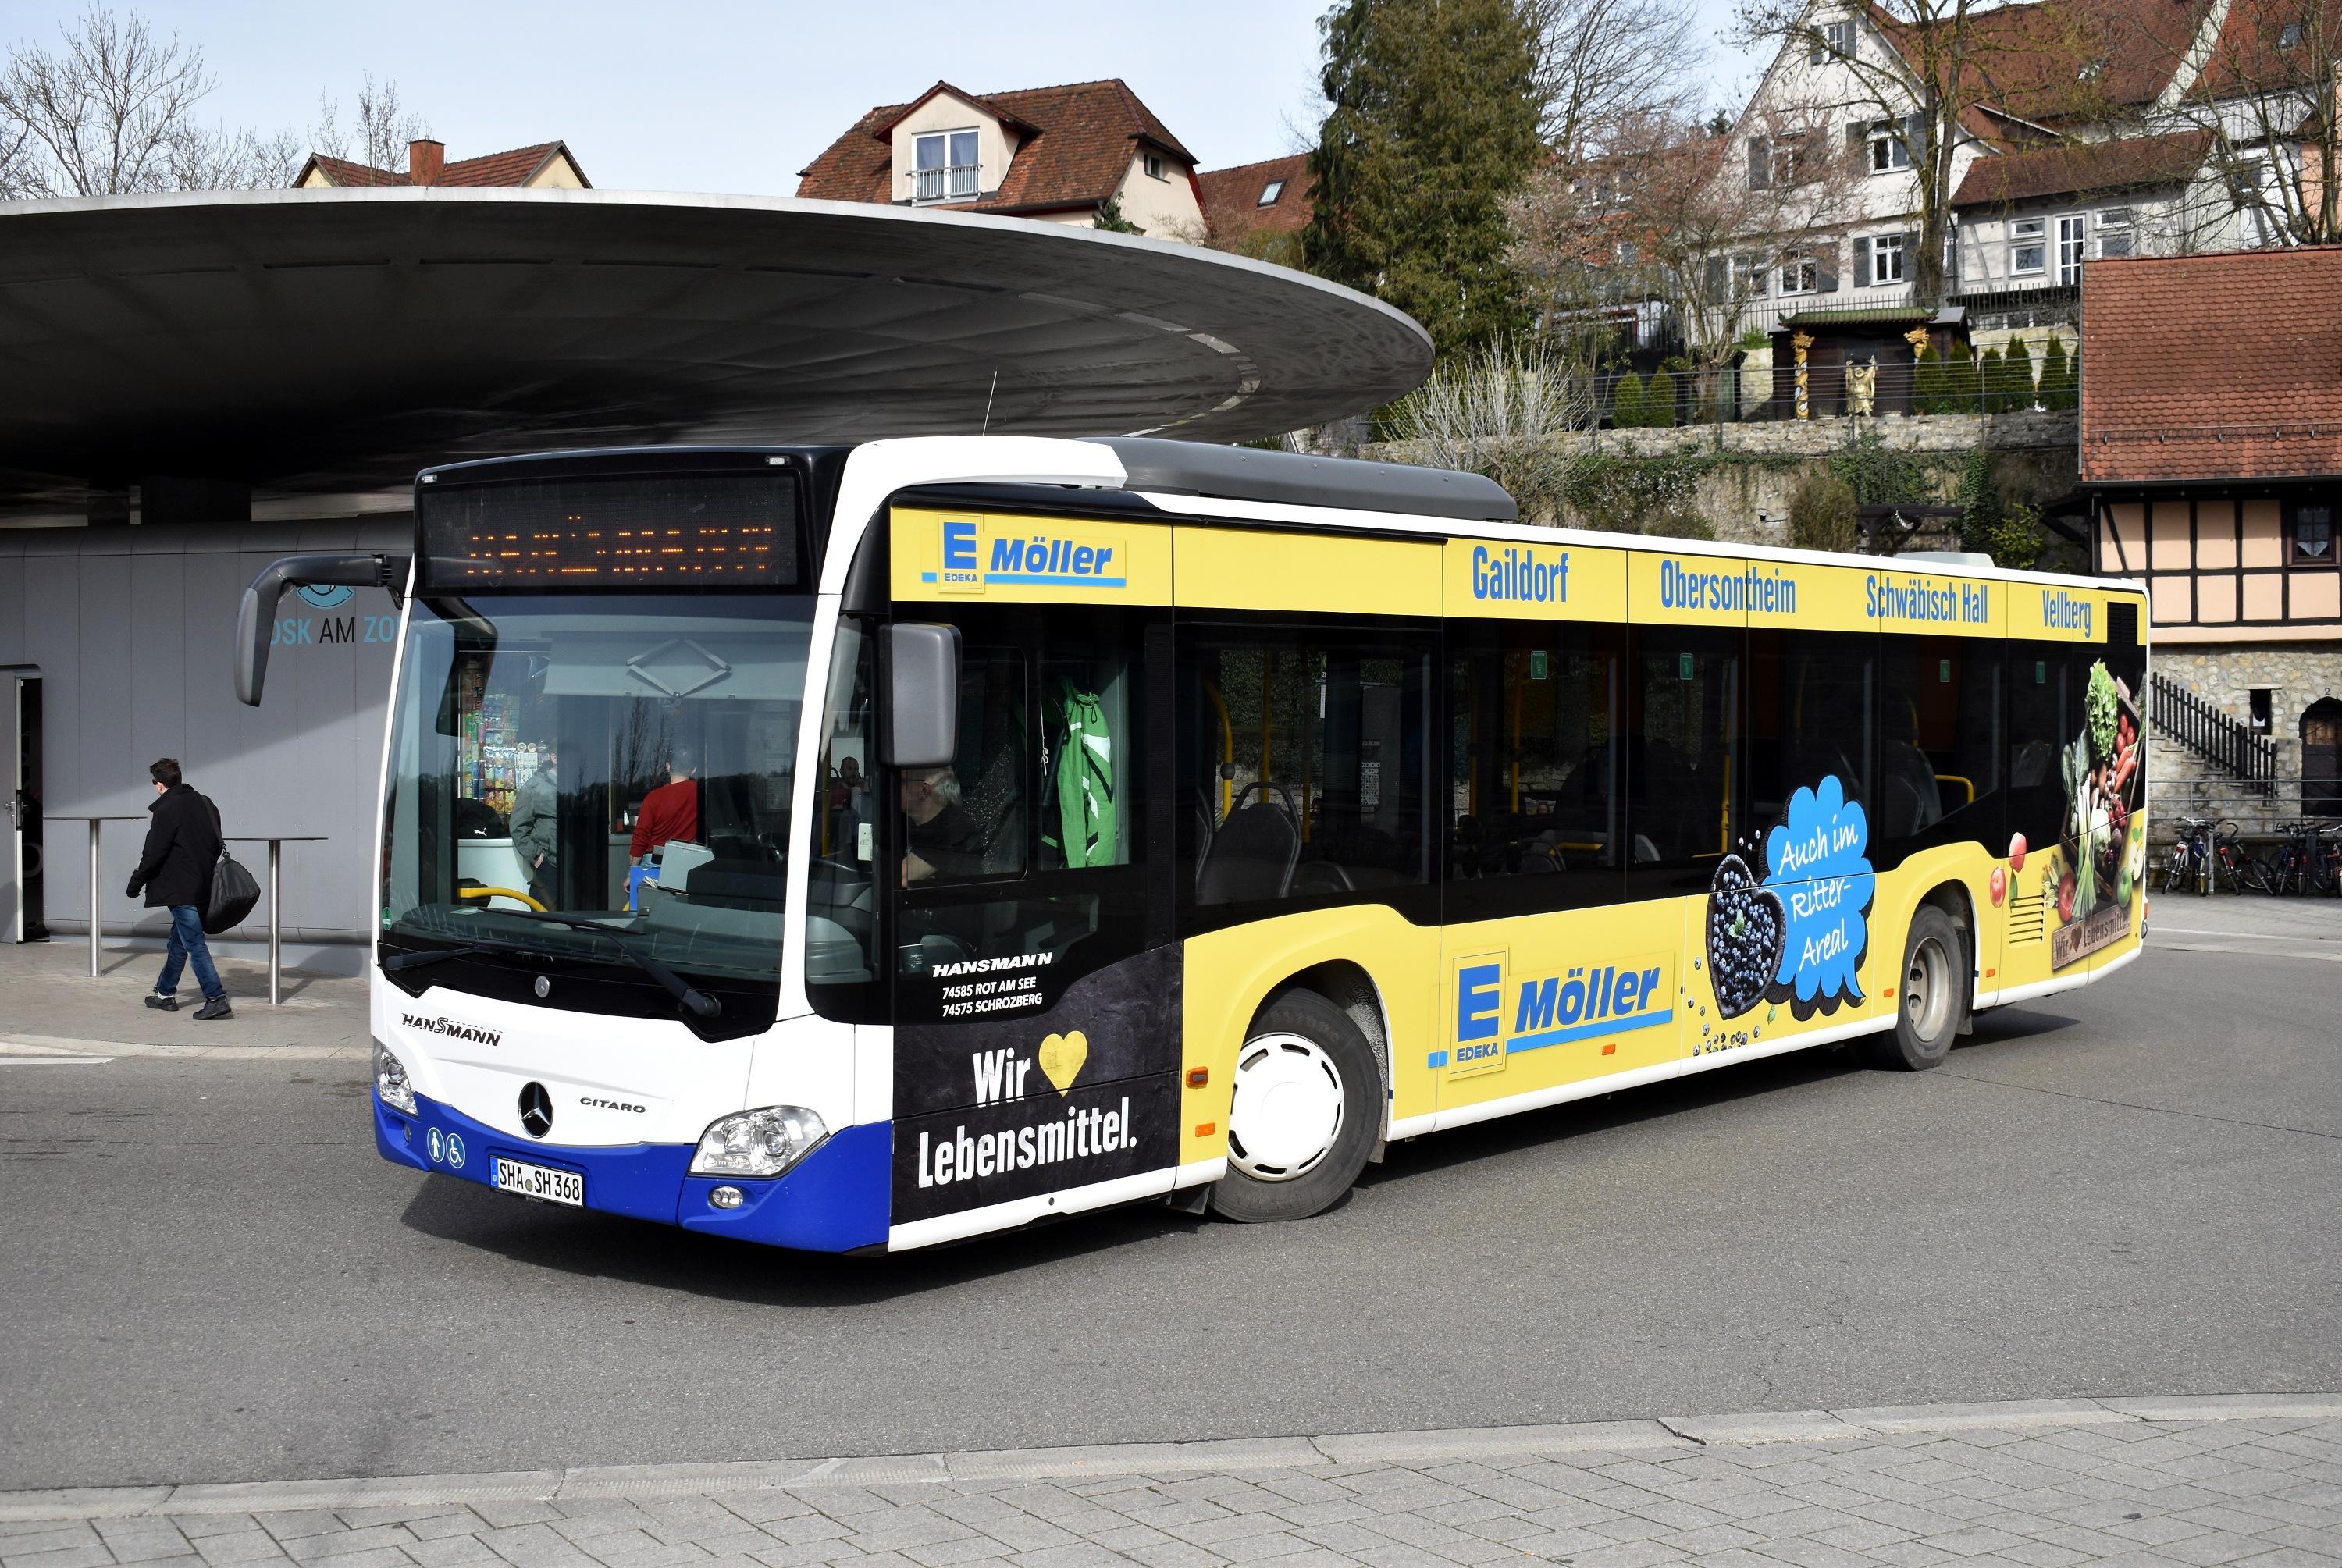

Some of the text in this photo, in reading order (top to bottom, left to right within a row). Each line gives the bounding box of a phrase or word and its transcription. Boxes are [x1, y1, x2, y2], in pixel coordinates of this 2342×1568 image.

[990, 536, 1113, 575] Möller
[1472, 545, 1569, 603] Gaildorf
[944, 572, 978, 583] EDEKA
[1660, 558, 1796, 613] Obersontheim
[1866, 574, 1988, 624] Schwäbisch Hall
[2041, 589, 2091, 638] Vellberg
[319, 617, 355, 645] AM
[363, 614, 401, 643] ZO
[2324, 687, 2331, 696] 2
[1778, 814, 1859, 876] Auch im
[1790, 875, 1853, 923] Ritter-
[1799, 918, 1849, 972] Areal
[2055, 936, 2068, 961] Wir
[932, 951, 1053, 978] HANSMANN
[942, 976, 1037, 1000] 74585 ROT AM SEE
[942, 992, 1043, 1017] 74575 SCHROZBERG
[1514, 965, 1660, 1033] Möller
[401, 1012, 501, 1047] HANSMANN
[1456, 1042, 1499, 1063] EDEKA
[972, 1047, 1031, 1108] Wir
[579, 1097, 646, 1114] CITARO
[917, 1096, 1137, 1189] Lebensmittel.
[500, 1162, 524, 1189] SHA
